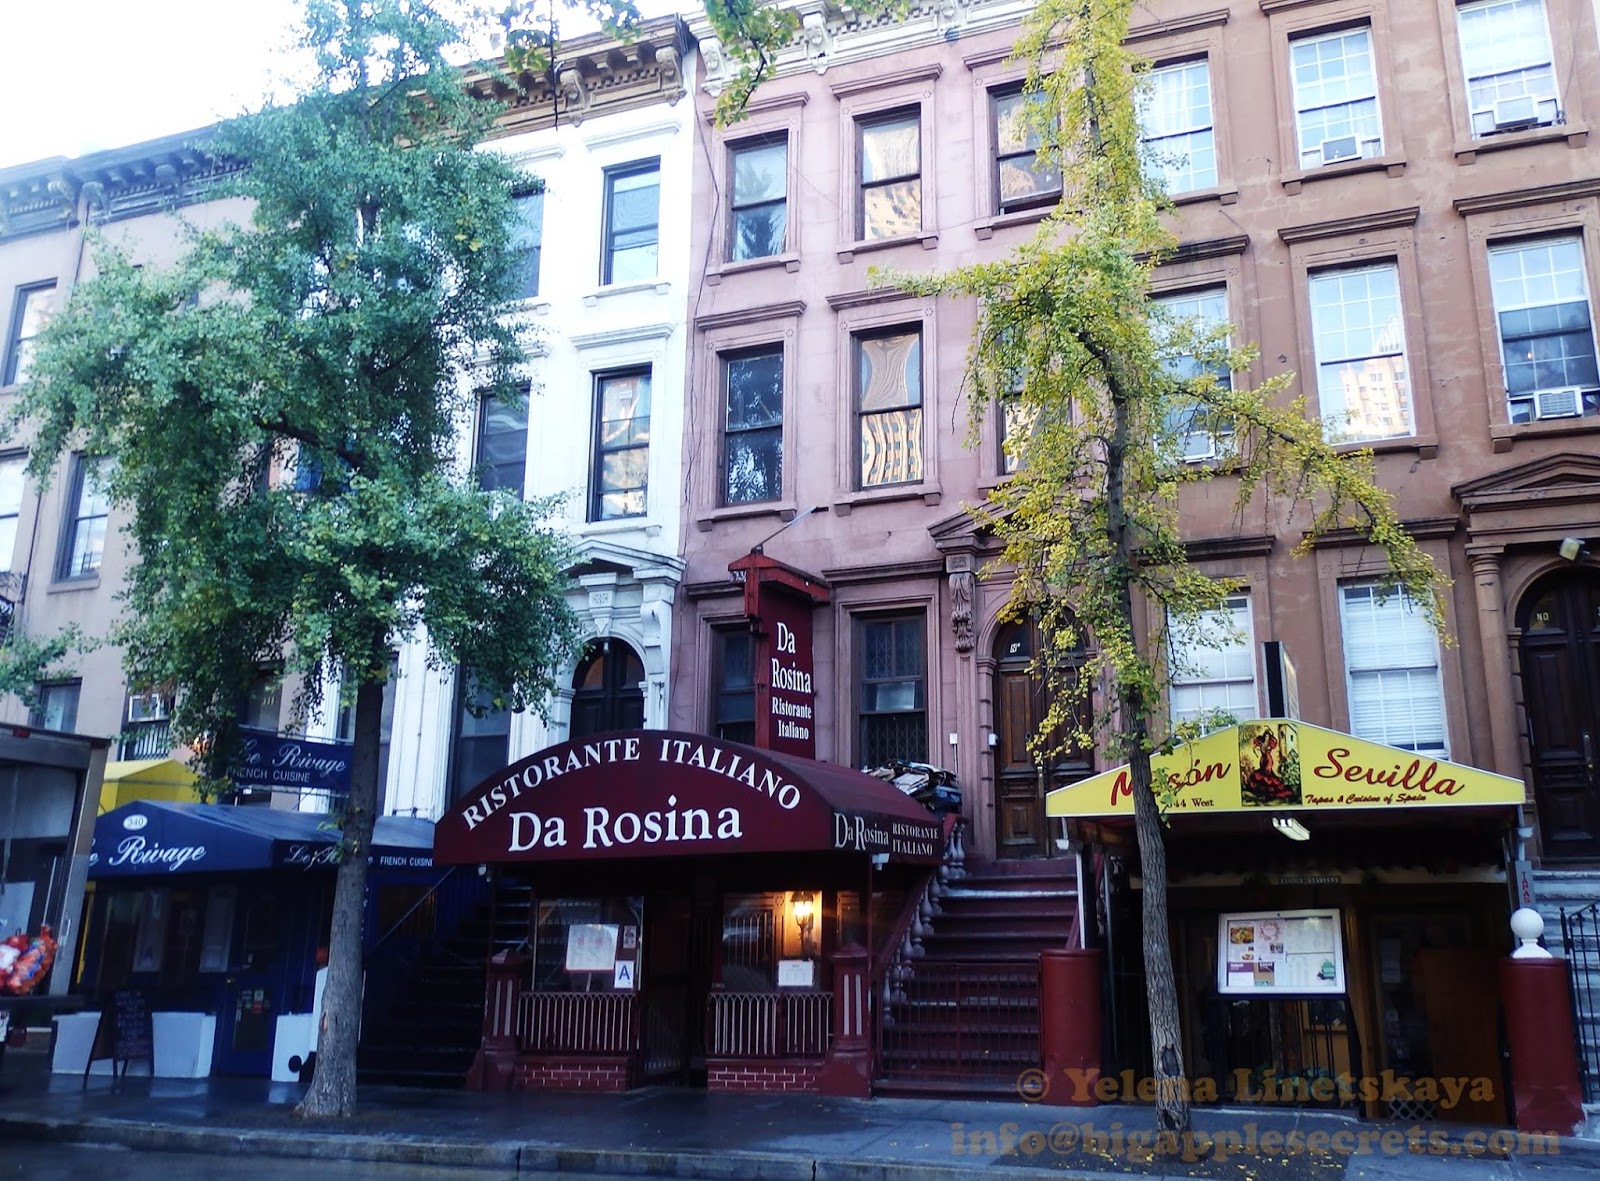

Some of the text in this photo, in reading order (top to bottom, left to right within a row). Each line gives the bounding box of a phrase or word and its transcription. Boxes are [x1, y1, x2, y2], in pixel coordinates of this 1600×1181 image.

[777, 621, 796, 654] Da
[771, 658, 811, 694] Rosina
[771, 697, 812, 719] Ristorante
[777, 719, 809, 740] Italiano
[272, 743, 347, 777] Rivage
[1313, 748, 1465, 796] Sevilla
[272, 769, 311, 782] CUISINE
[462, 738, 801, 831] RISTORANTE ITALIANO
[1110, 759, 1231, 807] Msón
[1191, 797, 1214, 807] West
[1305, 794, 1334, 805] Tapas
[1346, 793, 1381, 805] Cuisine
[1383, 793, 1394, 805] of
[1396, 793, 1427, 804] Spain
[508, 794, 743, 852] Da Rosina
[834, 812, 889, 851] Da Rosina
[892, 822, 939, 840] RISTORANTE
[108, 835, 207, 872] Rivage
[380, 855, 407, 866] FRENCH
[409, 857, 433, 867] CUISIN
[892, 838, 933, 857] ITALIANO
[618, 965, 630, 980] A
